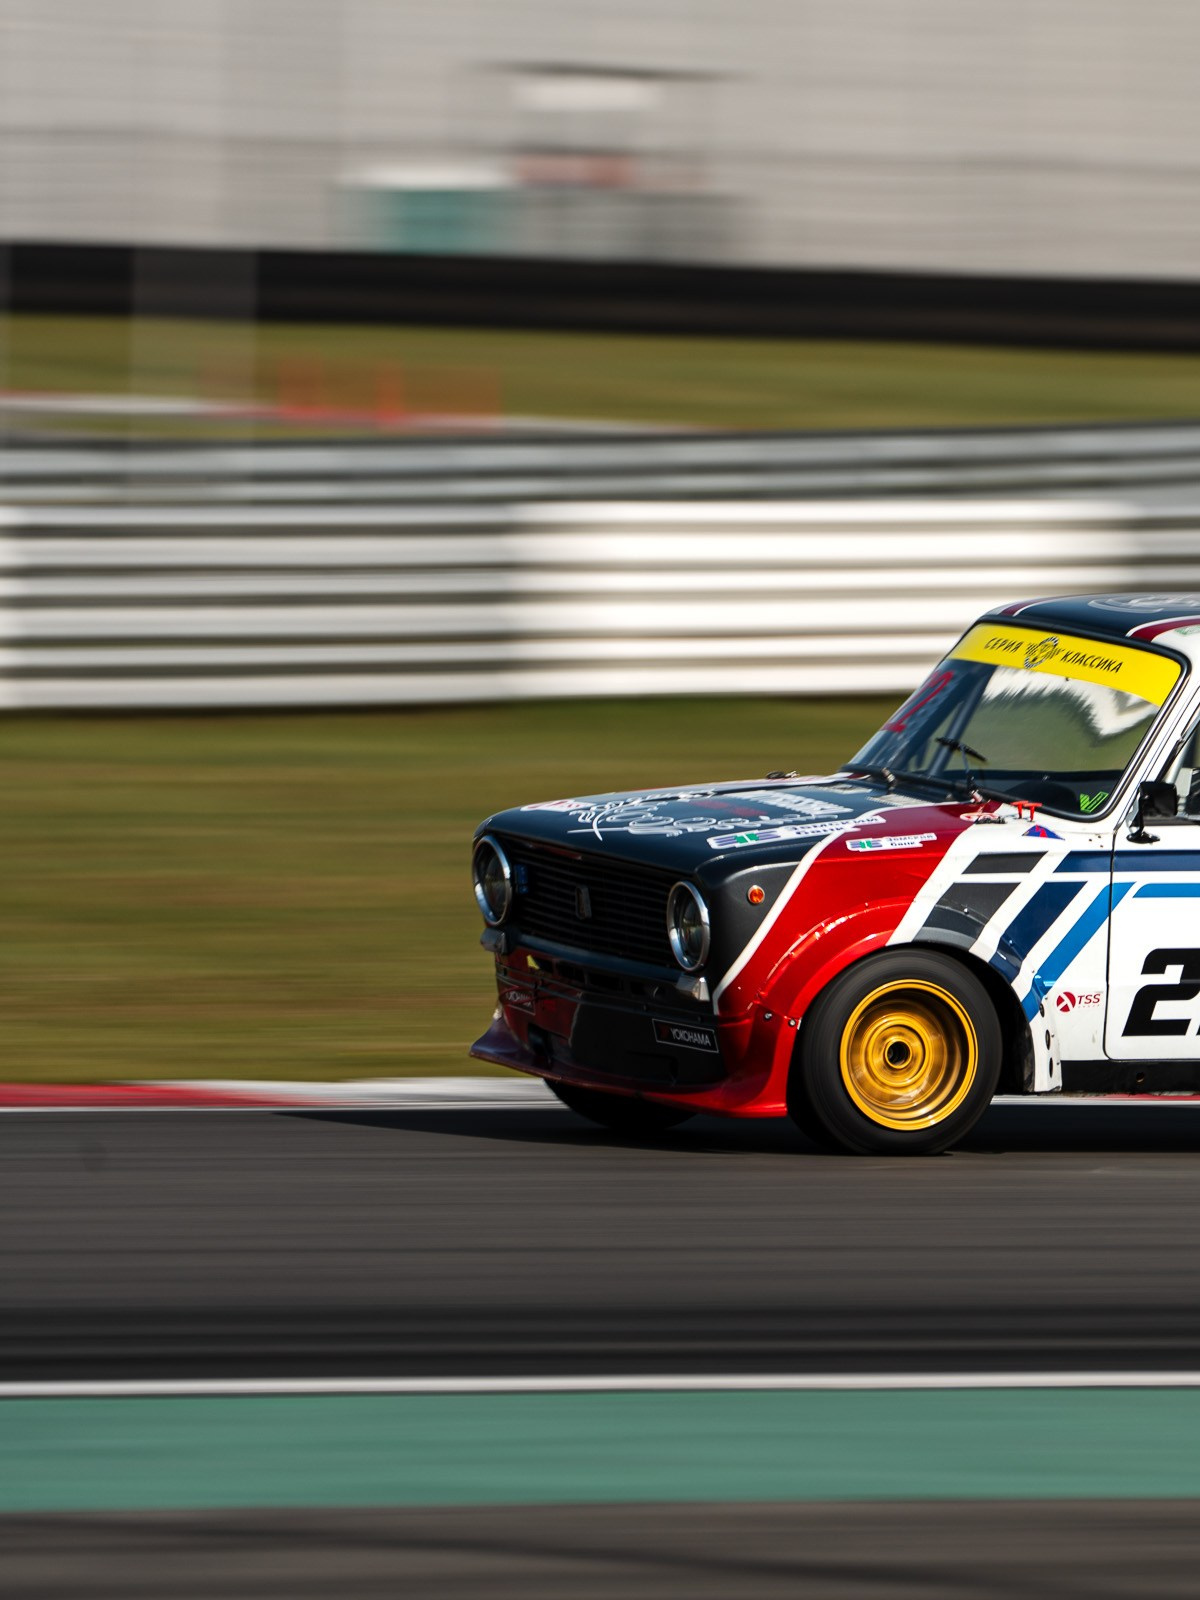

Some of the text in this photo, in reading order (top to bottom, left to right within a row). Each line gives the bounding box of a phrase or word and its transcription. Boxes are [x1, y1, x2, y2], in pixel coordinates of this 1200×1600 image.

[984, 637, 1123, 674] СЕРИЯ КЛАССИКА
[1077, 993, 1101, 1005] TSS
[670, 1027, 713, 1047] YOKOHAMA
